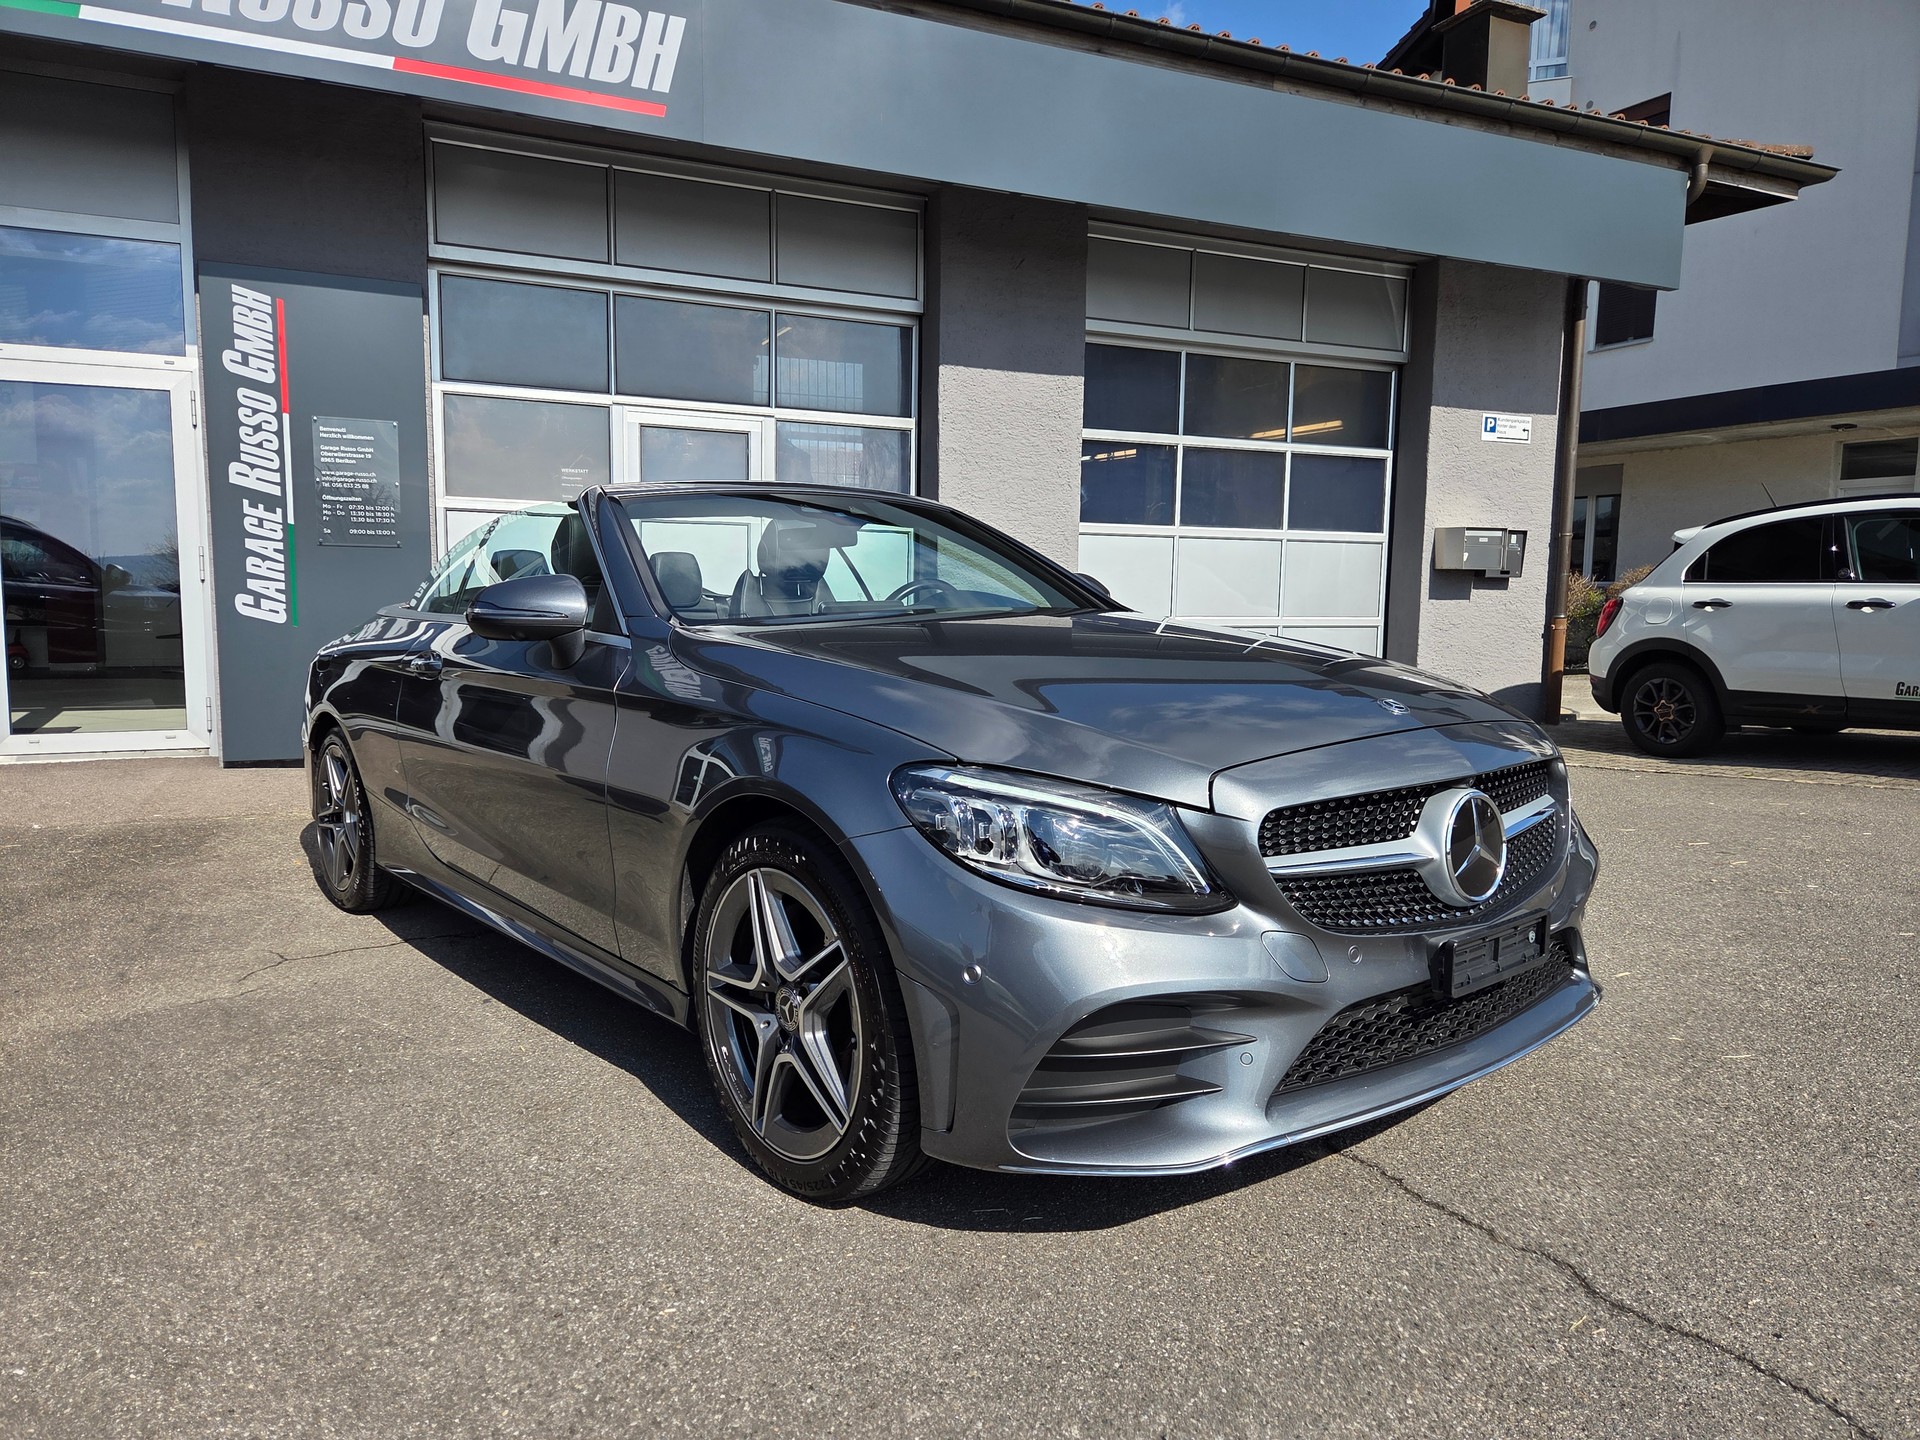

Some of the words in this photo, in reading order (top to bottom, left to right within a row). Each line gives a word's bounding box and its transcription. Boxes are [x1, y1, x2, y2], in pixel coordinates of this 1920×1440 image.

[228, 386, 281, 497] RUSSO
[234, 498, 288, 625] GARAGE
[1895, 681, 1920, 697] GAR
